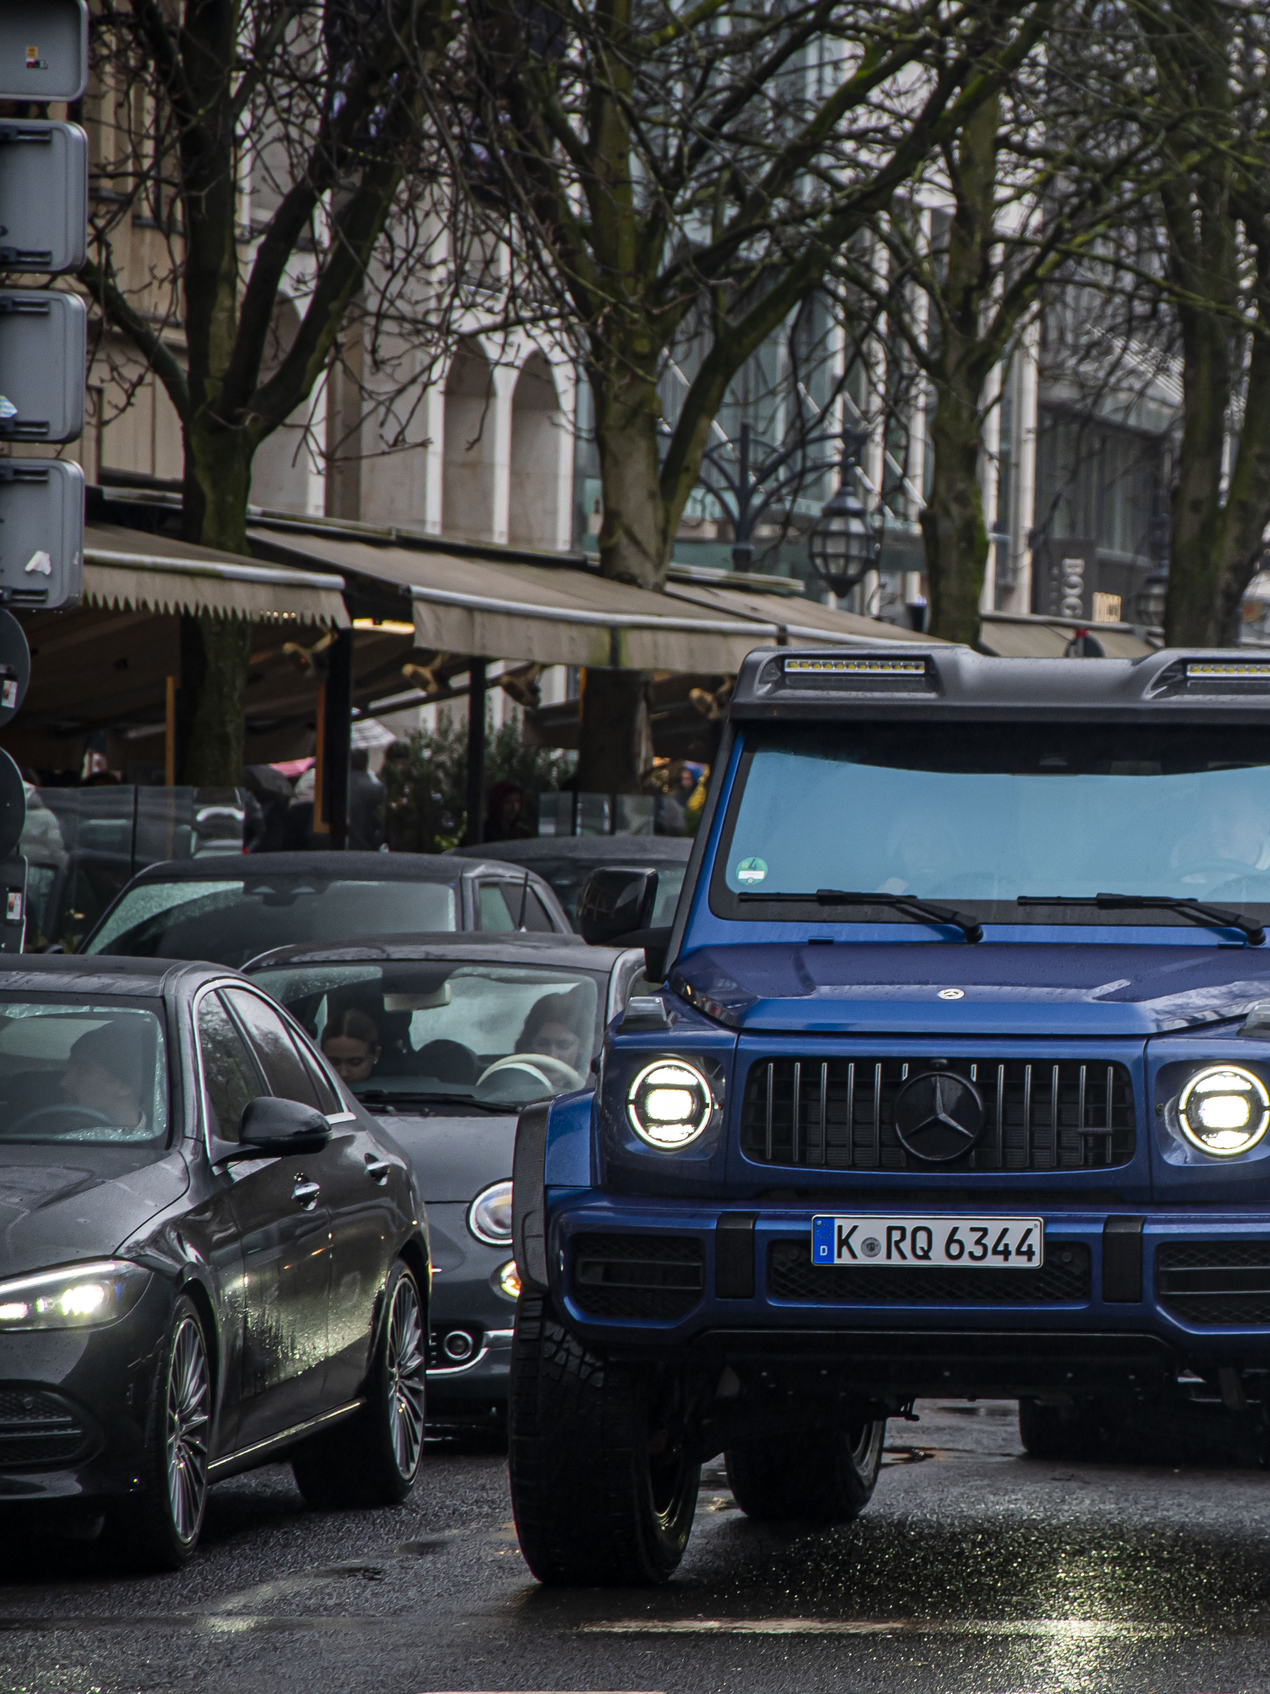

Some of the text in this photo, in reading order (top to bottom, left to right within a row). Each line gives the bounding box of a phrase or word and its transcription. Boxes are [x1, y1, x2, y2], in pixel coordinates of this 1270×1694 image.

[747, 857, 758, 871] 4
[836, 1224, 1037, 1262] K RQ 6344
[819, 1245, 828, 1256] D
